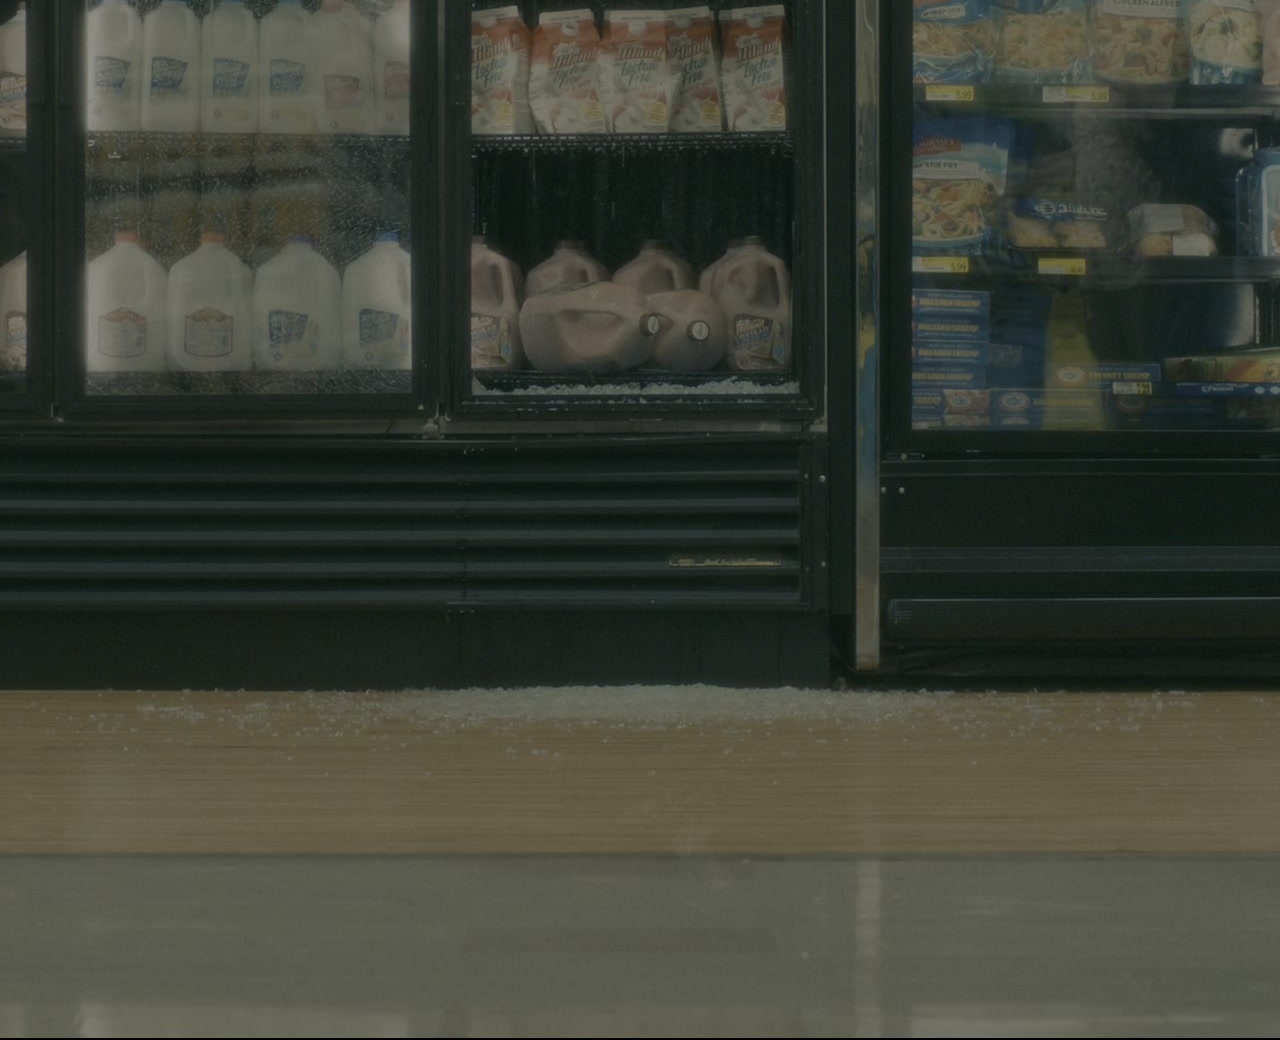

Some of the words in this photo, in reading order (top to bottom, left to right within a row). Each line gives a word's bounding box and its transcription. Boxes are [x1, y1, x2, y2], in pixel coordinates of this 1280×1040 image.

[956, 90, 971, 99] 5.99
[1091, 90, 1107, 100] 5.99
[951, 263, 967, 272] 5.99
